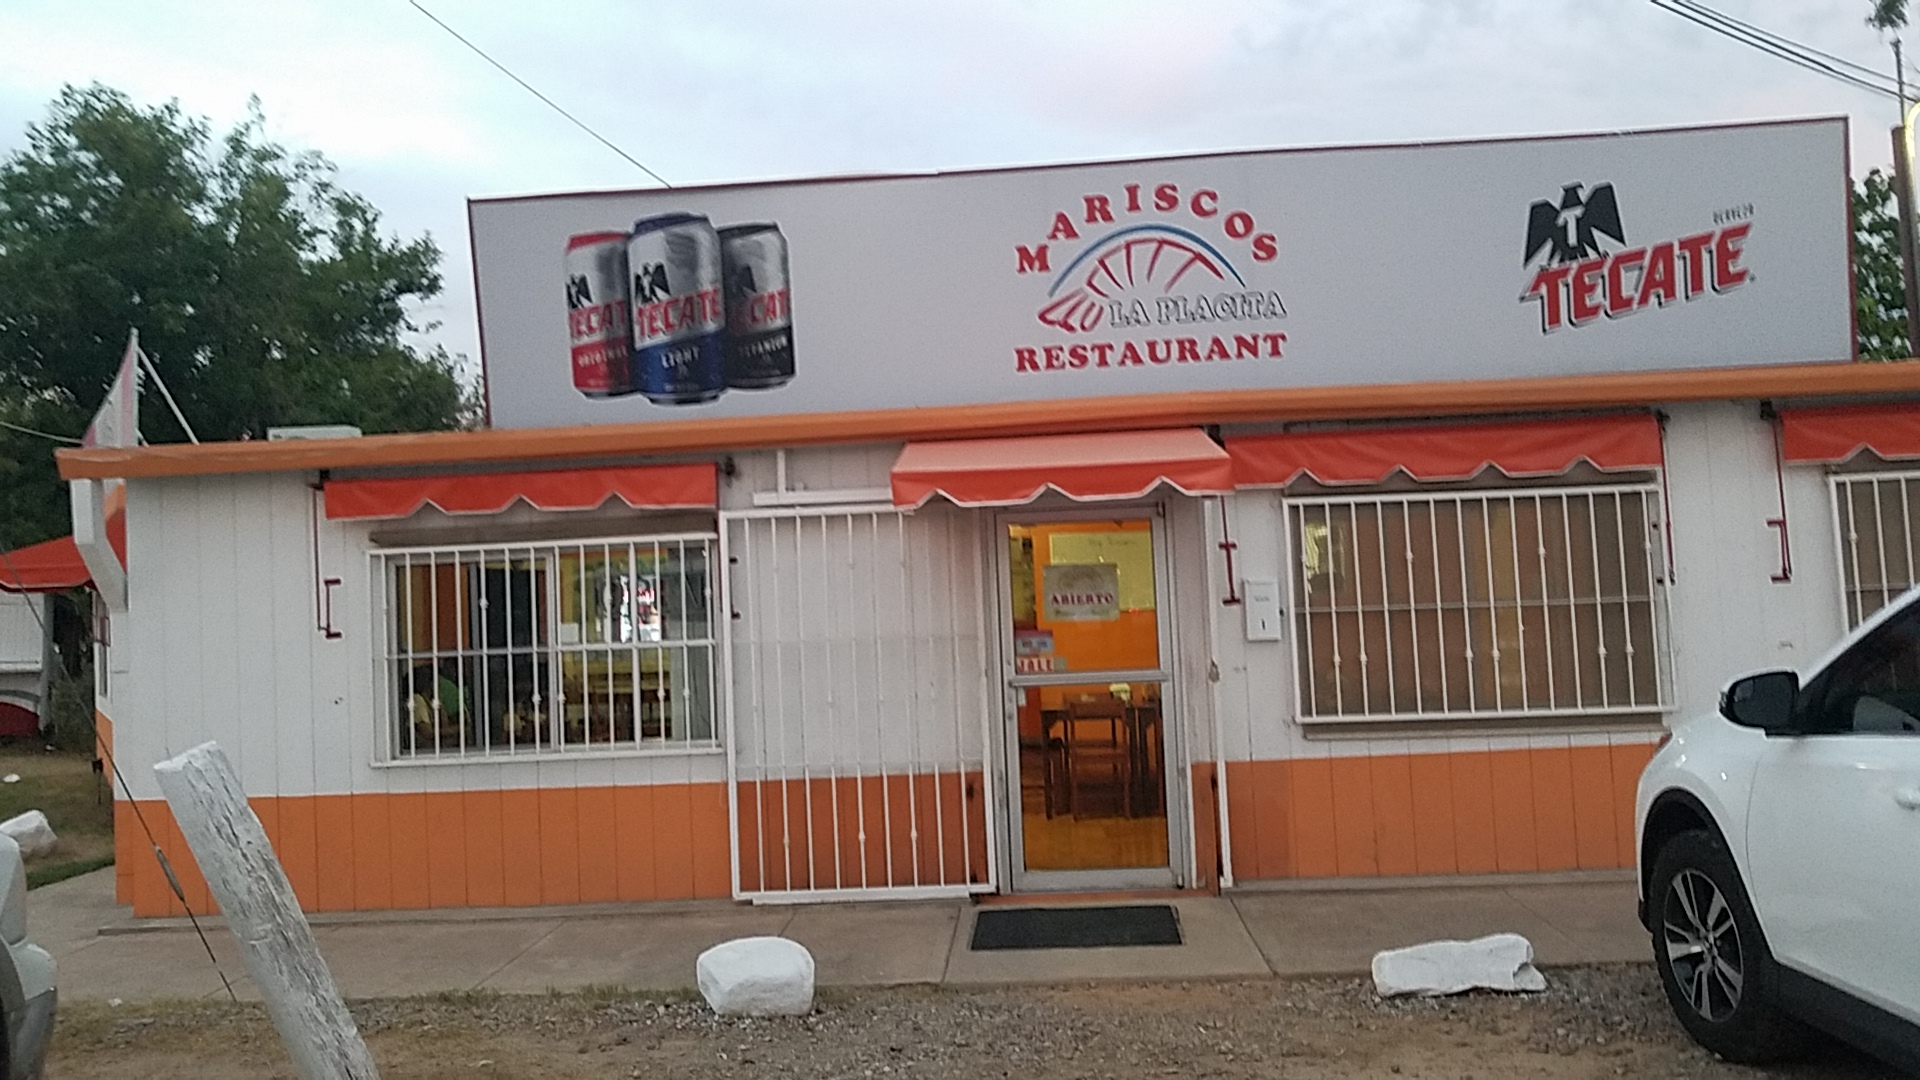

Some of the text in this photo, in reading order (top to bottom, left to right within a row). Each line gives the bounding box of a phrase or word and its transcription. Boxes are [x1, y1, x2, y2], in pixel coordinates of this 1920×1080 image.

[1015, 183, 1278, 274] MARISCOS
[1519, 221, 1753, 335] TECATE
[636, 288, 721, 338] TECATE
[1109, 291, 1288, 328] LA PLACITA
[660, 345, 700, 369] LIGHT
[1014, 332, 1288, 373] RESTAURANT
[1051, 592, 1114, 608] ABIERTO
